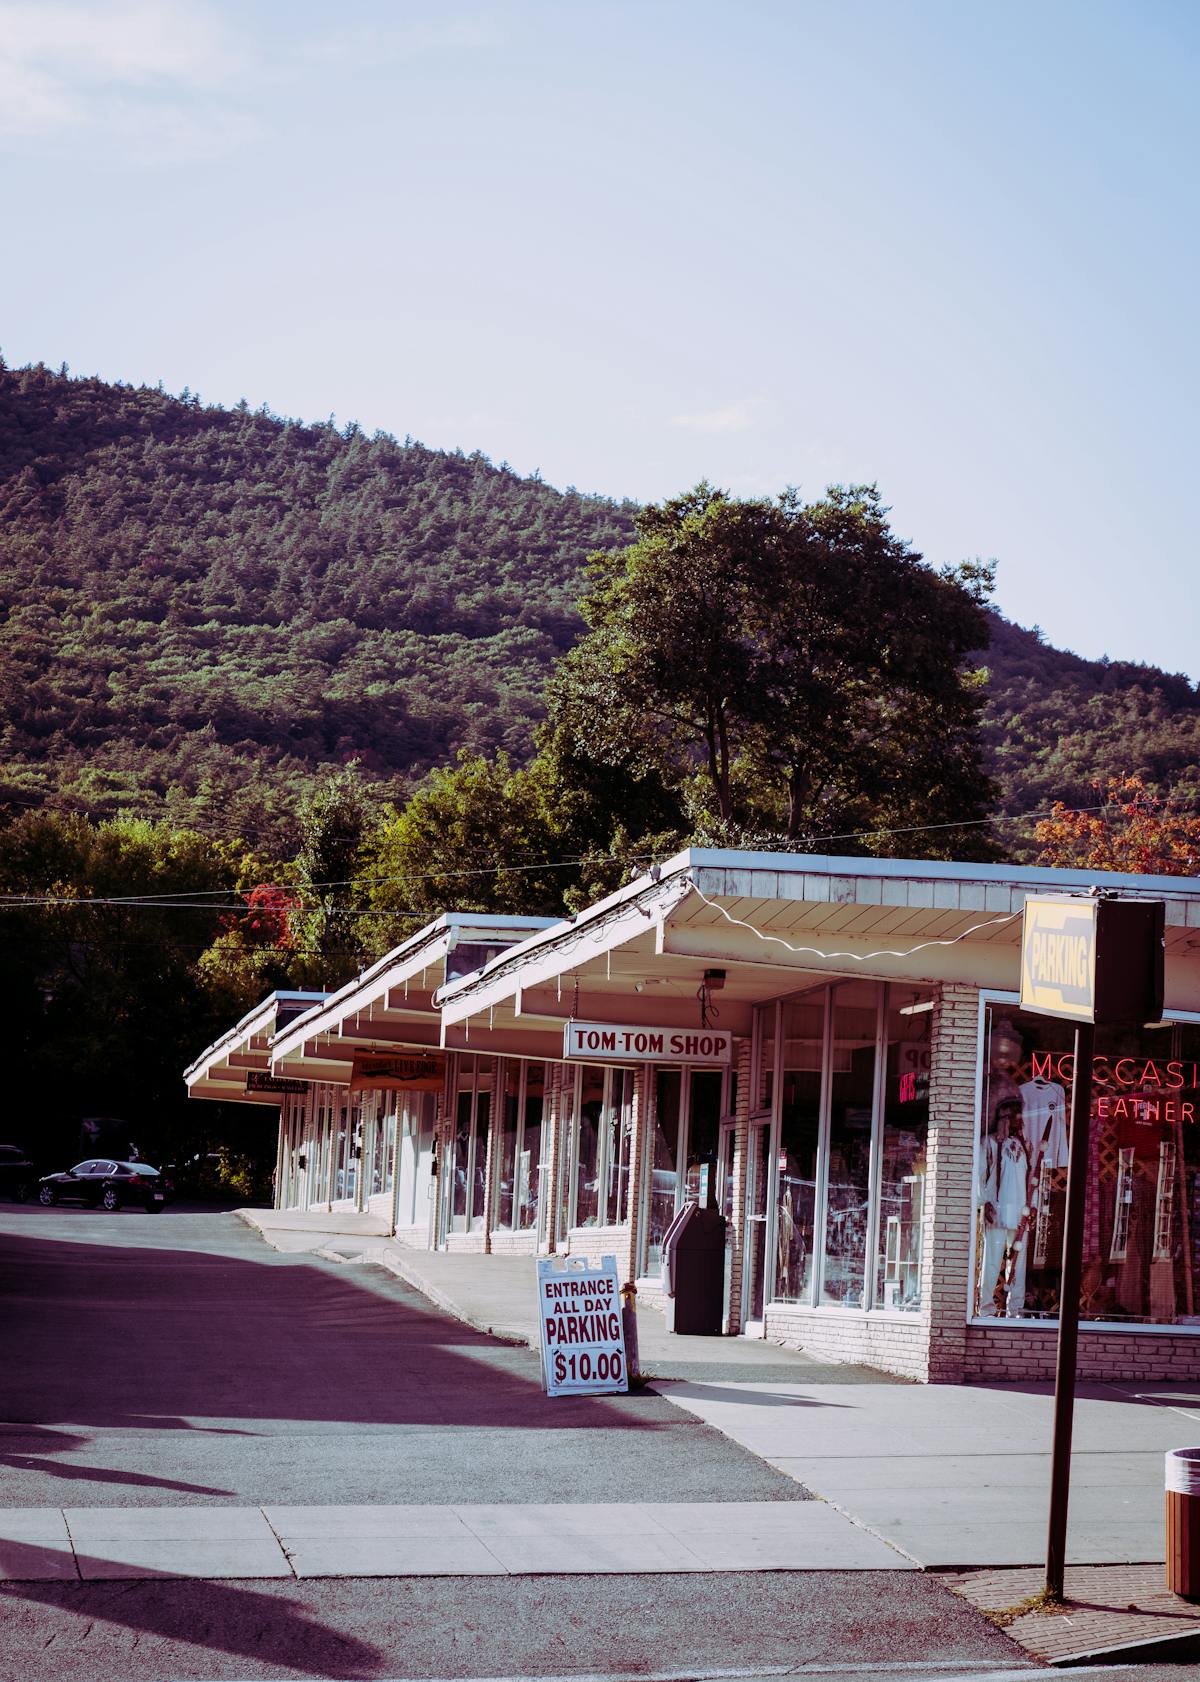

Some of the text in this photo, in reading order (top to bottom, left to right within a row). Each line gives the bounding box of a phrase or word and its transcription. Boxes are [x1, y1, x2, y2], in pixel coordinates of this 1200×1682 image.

[1032, 932, 1087, 990] PARKING
[574, 1030, 727, 1056] TOM-TOM SHOP
[1089, 1097, 1195, 1124] EATHER
[545, 1279, 614, 1298] ENTRANCE
[554, 1298, 612, 1314] ALL DAY
[546, 1313, 620, 1345] PARKING
[555, 1352, 621, 1383] $10.00
